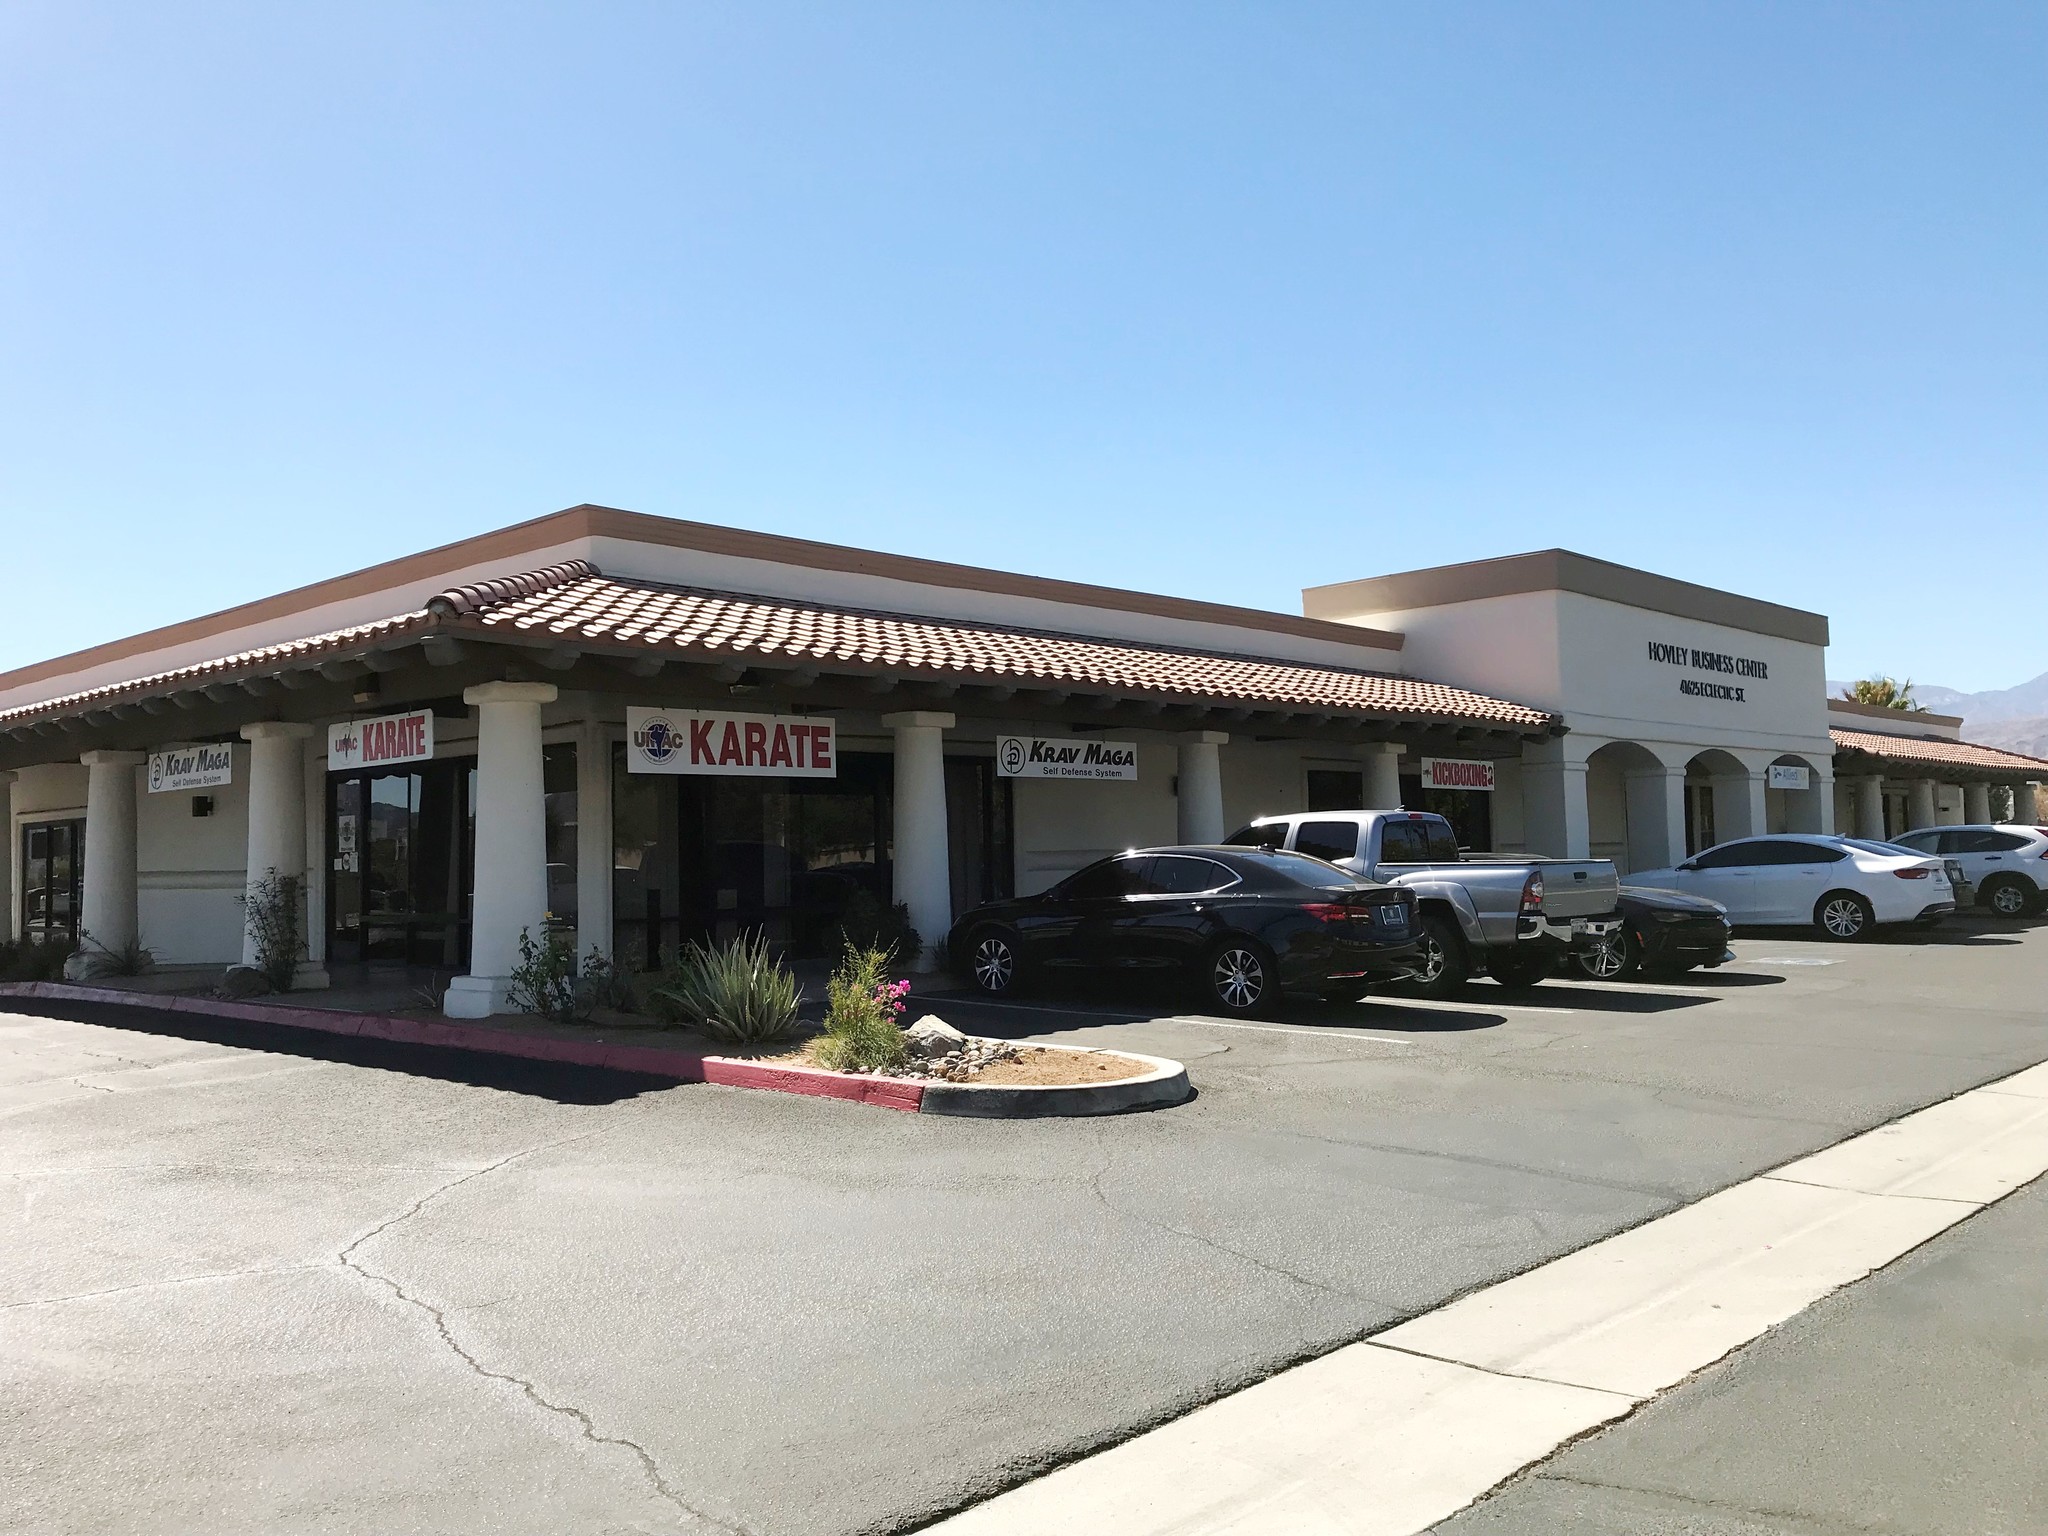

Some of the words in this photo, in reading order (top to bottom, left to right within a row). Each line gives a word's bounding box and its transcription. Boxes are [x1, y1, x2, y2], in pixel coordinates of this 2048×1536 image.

[1648, 641, 1688, 666] HOVLEY
[1691, 649, 1734, 674] BUSINESS
[1735, 657, 1768, 680] CENTER
[362, 715, 425, 761] KARATE
[690, 719, 832, 769] KARATE
[183, 778, 201, 786] Defense
[203, 776, 221, 784] System
[1043, 766, 1059, 775] Self
[1061, 767, 1093, 776] Defense
[1095, 768, 1122, 778] System
[1432, 762, 1487, 786] KICKBOXING
